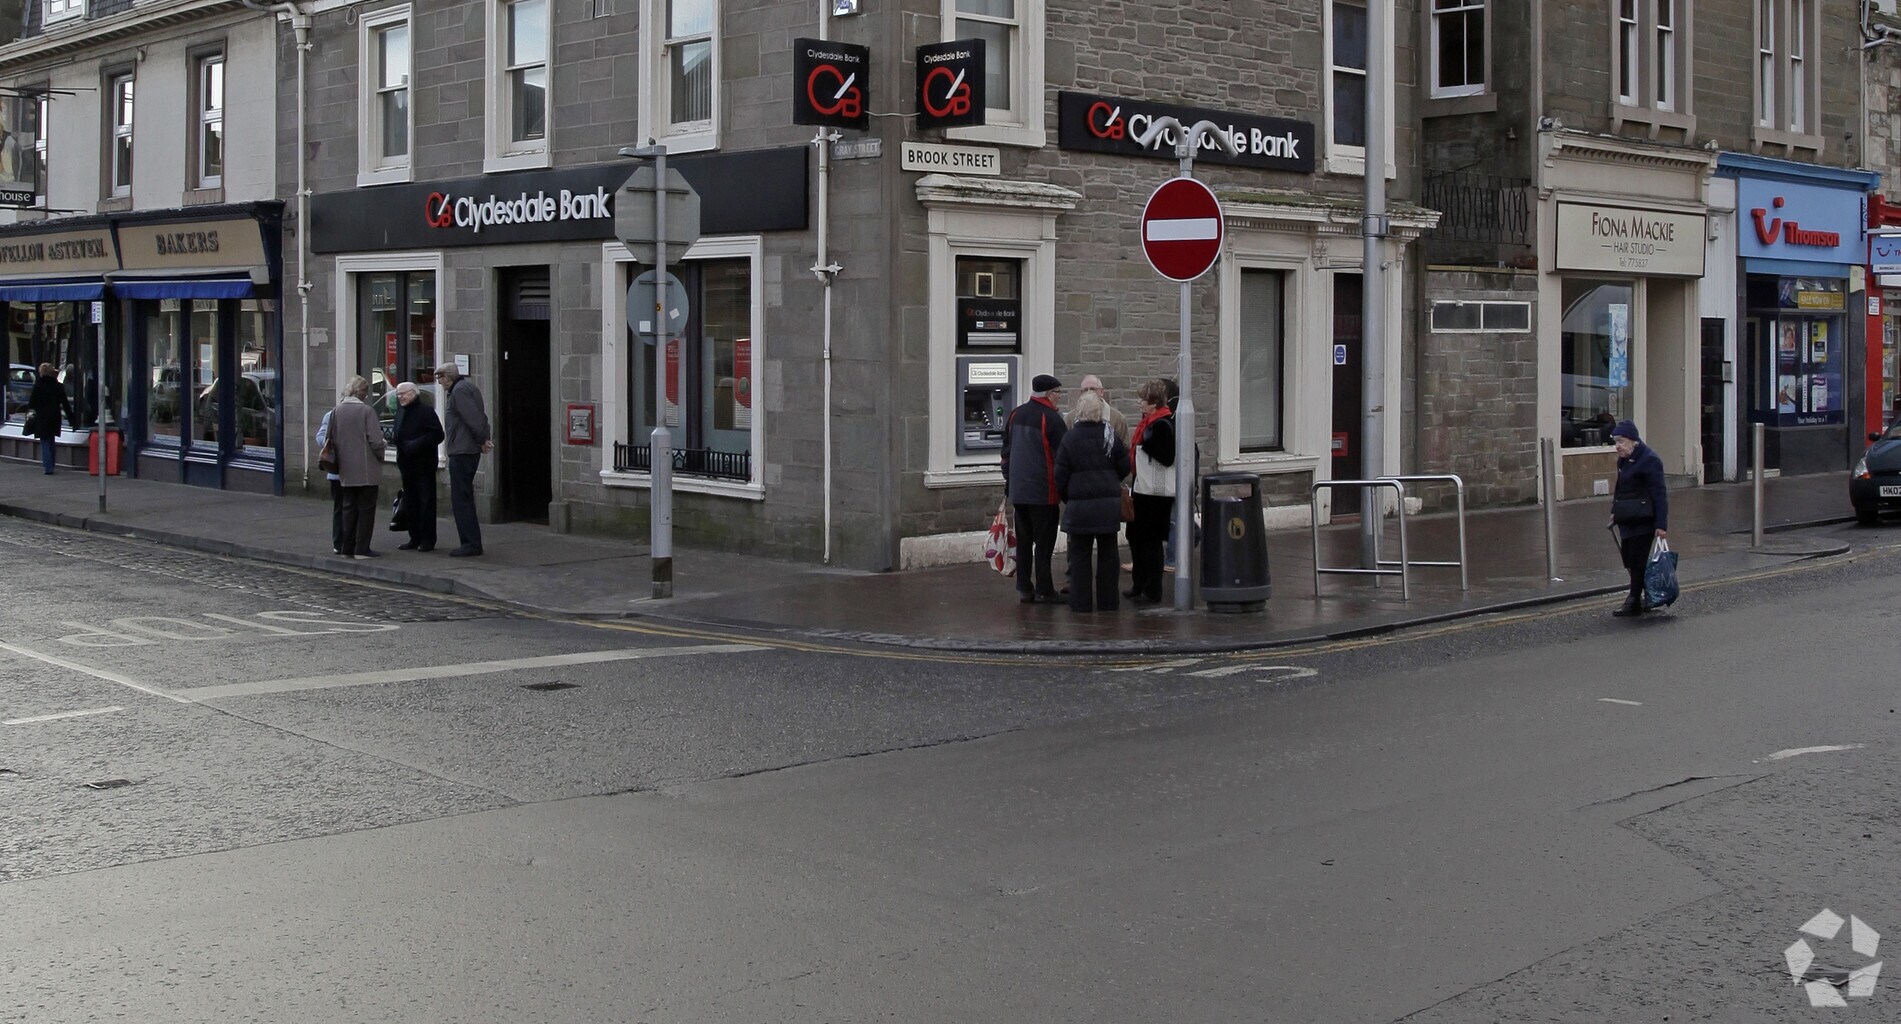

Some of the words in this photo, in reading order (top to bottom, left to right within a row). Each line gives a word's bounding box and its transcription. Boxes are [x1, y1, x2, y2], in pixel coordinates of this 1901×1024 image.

[807, 48, 843, 61] Clydesdale
[844, 53, 861, 63] Bank
[923, 53, 955, 64] Clydesdale
[956, 50, 971, 59] Bank
[1127, 113, 1247, 153] Clyddle
[1250, 126, 1300, 159] Bank
[834, 144, 853, 156] GRAY
[854, 142, 880, 155] STREET
[908, 149, 948, 165] BROOK
[952, 152, 995, 168] STREET
[454, 190, 557, 234] Clydesdale
[559, 185, 612, 221] Bank
[1592, 212, 1628, 238] FIONA
[1631, 215, 1675, 242] MACKIE
[1783, 221, 1840, 247] Thomson
[0, 242, 45, 264] FELLOW
[155, 230, 220, 256] BAKERS
[1613, 242, 1629, 254] HAIR
[1630, 242, 1655, 256] STUDIO
[57, 610, 401, 648] STOP
